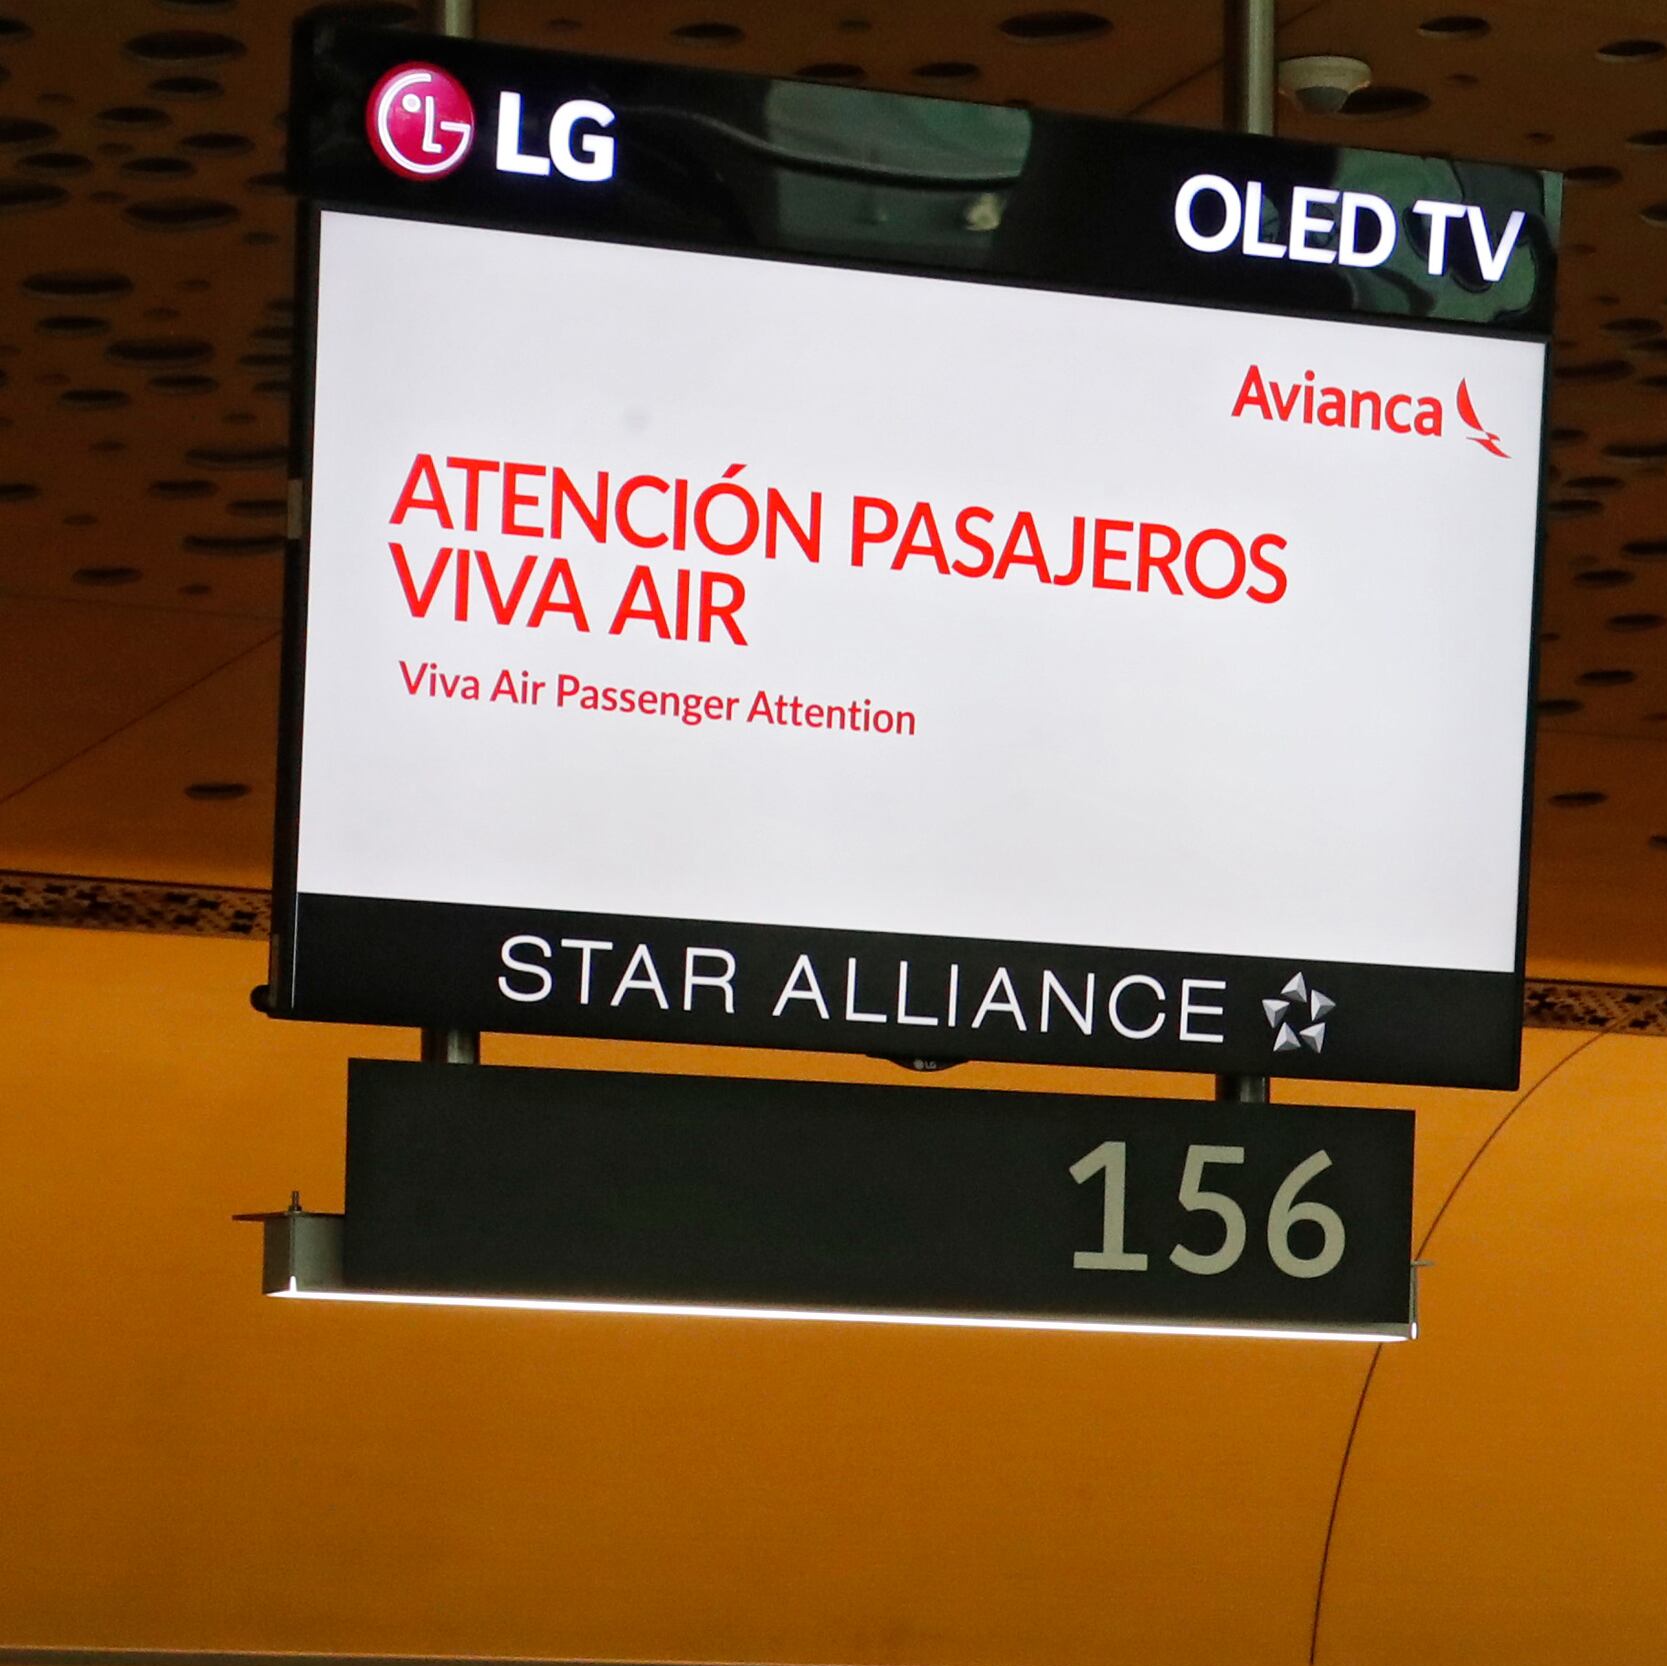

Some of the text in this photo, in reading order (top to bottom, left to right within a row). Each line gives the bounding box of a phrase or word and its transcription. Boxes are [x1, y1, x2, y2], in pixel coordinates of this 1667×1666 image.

[496, 91, 615, 182] LG
[1175, 174, 1524, 281] OLED TV
[1231, 365, 1443, 437] Avianca
[390, 453, 1288, 605] ATENCIÓN PASAJEROS
[389, 542, 748, 647] VIVA AIR
[400, 660, 916, 736] Viva Air Passenger Attention
[498, 935, 1226, 1042] STAR ALLIANCE
[1070, 1142, 1345, 1278] 156
